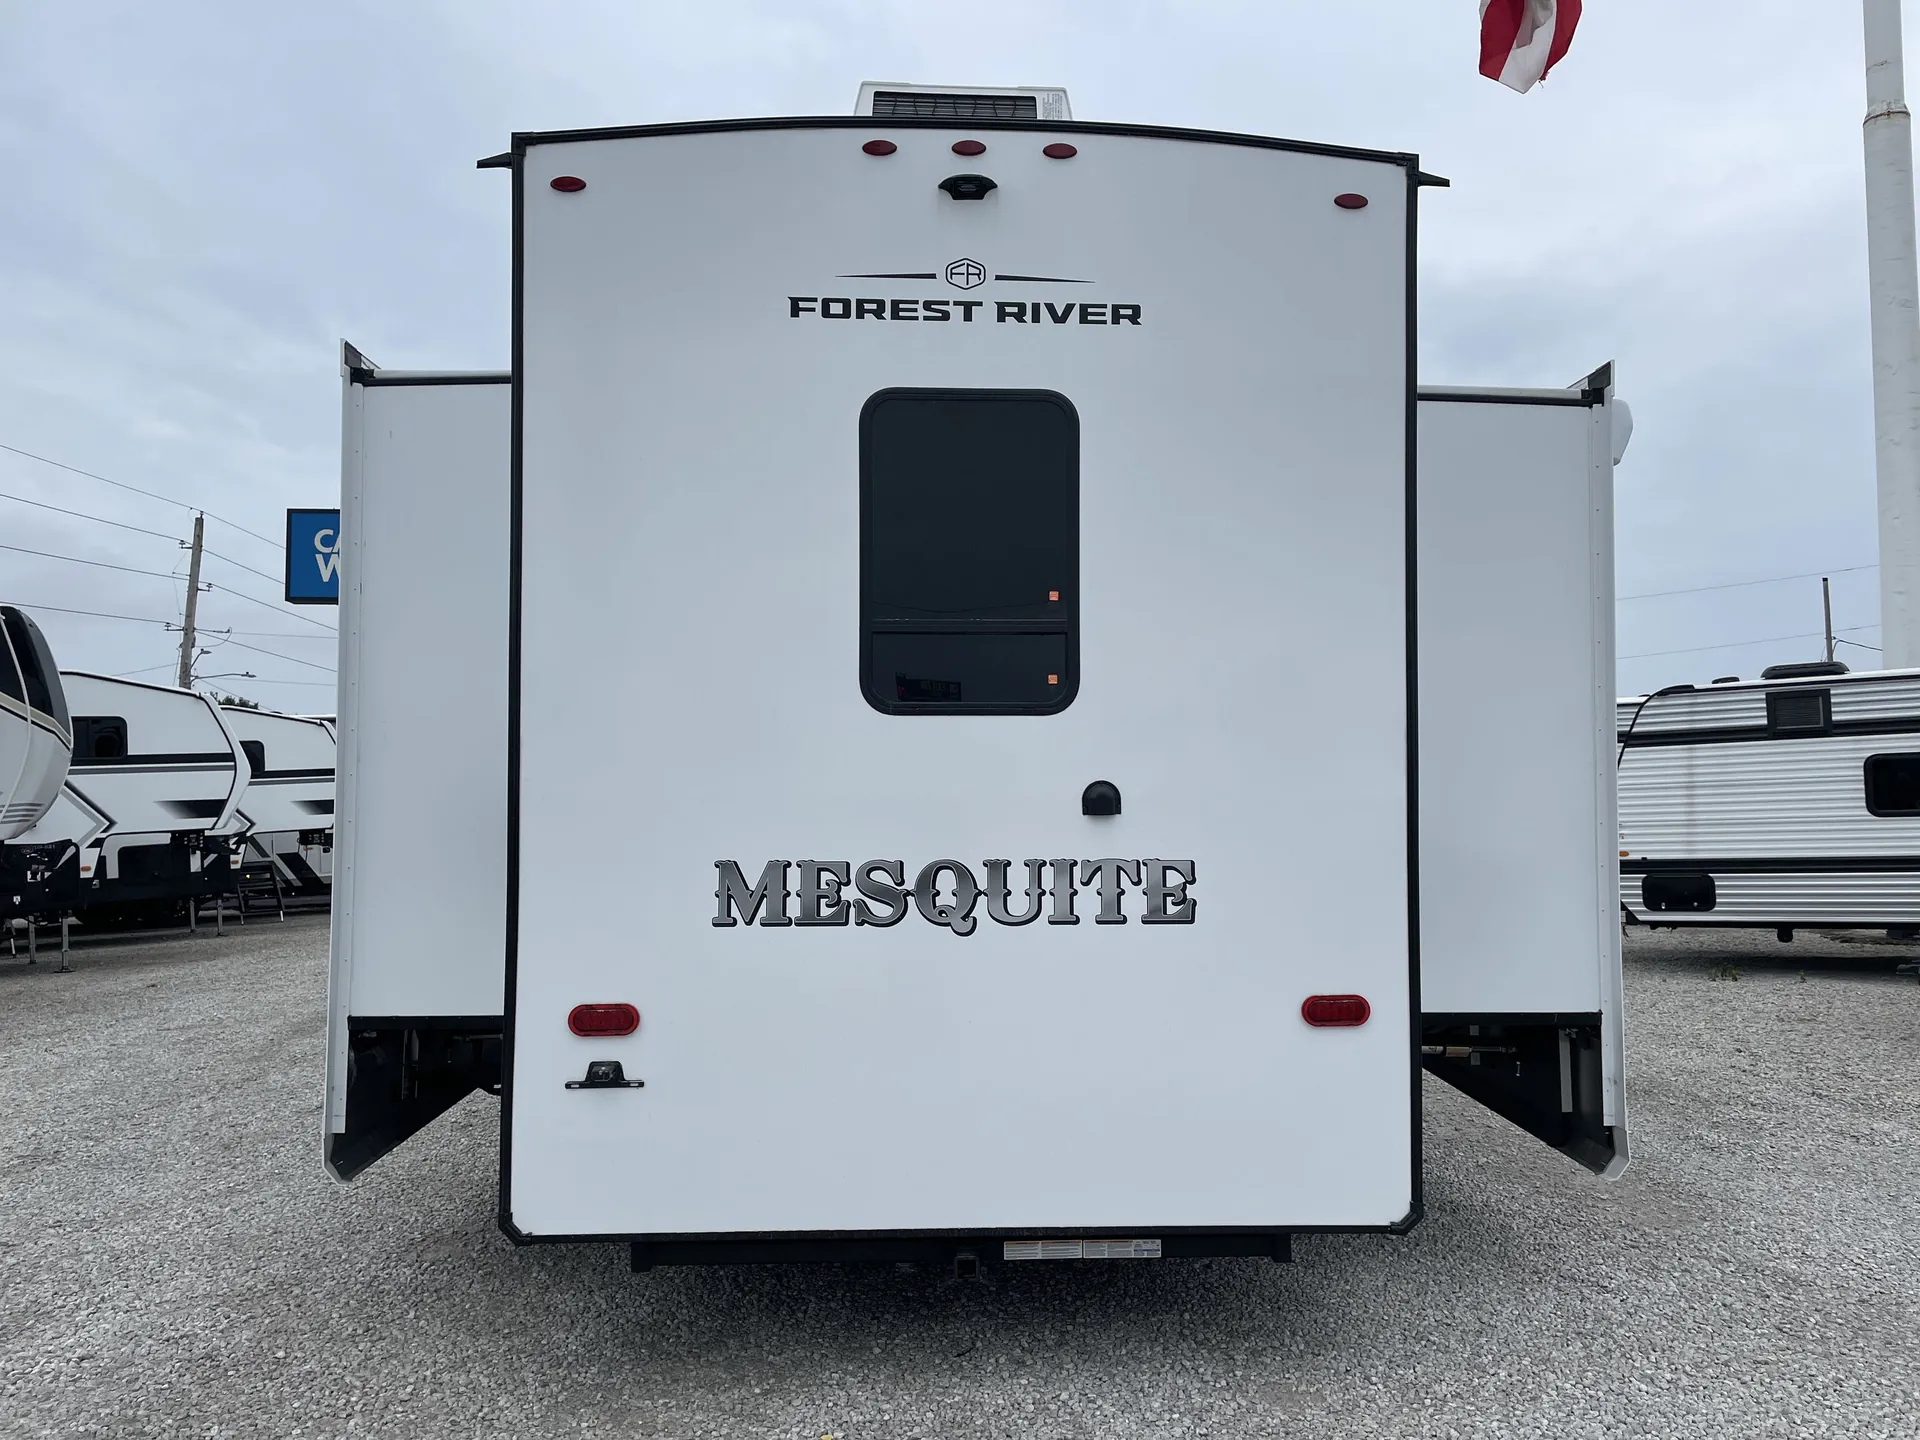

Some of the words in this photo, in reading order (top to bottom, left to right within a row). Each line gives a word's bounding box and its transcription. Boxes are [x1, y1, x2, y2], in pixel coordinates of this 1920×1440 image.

[787, 296, 983, 322] FOREST
[994, 300, 1143, 326] RIVER
[712, 858, 1197, 937] MESQUITE
